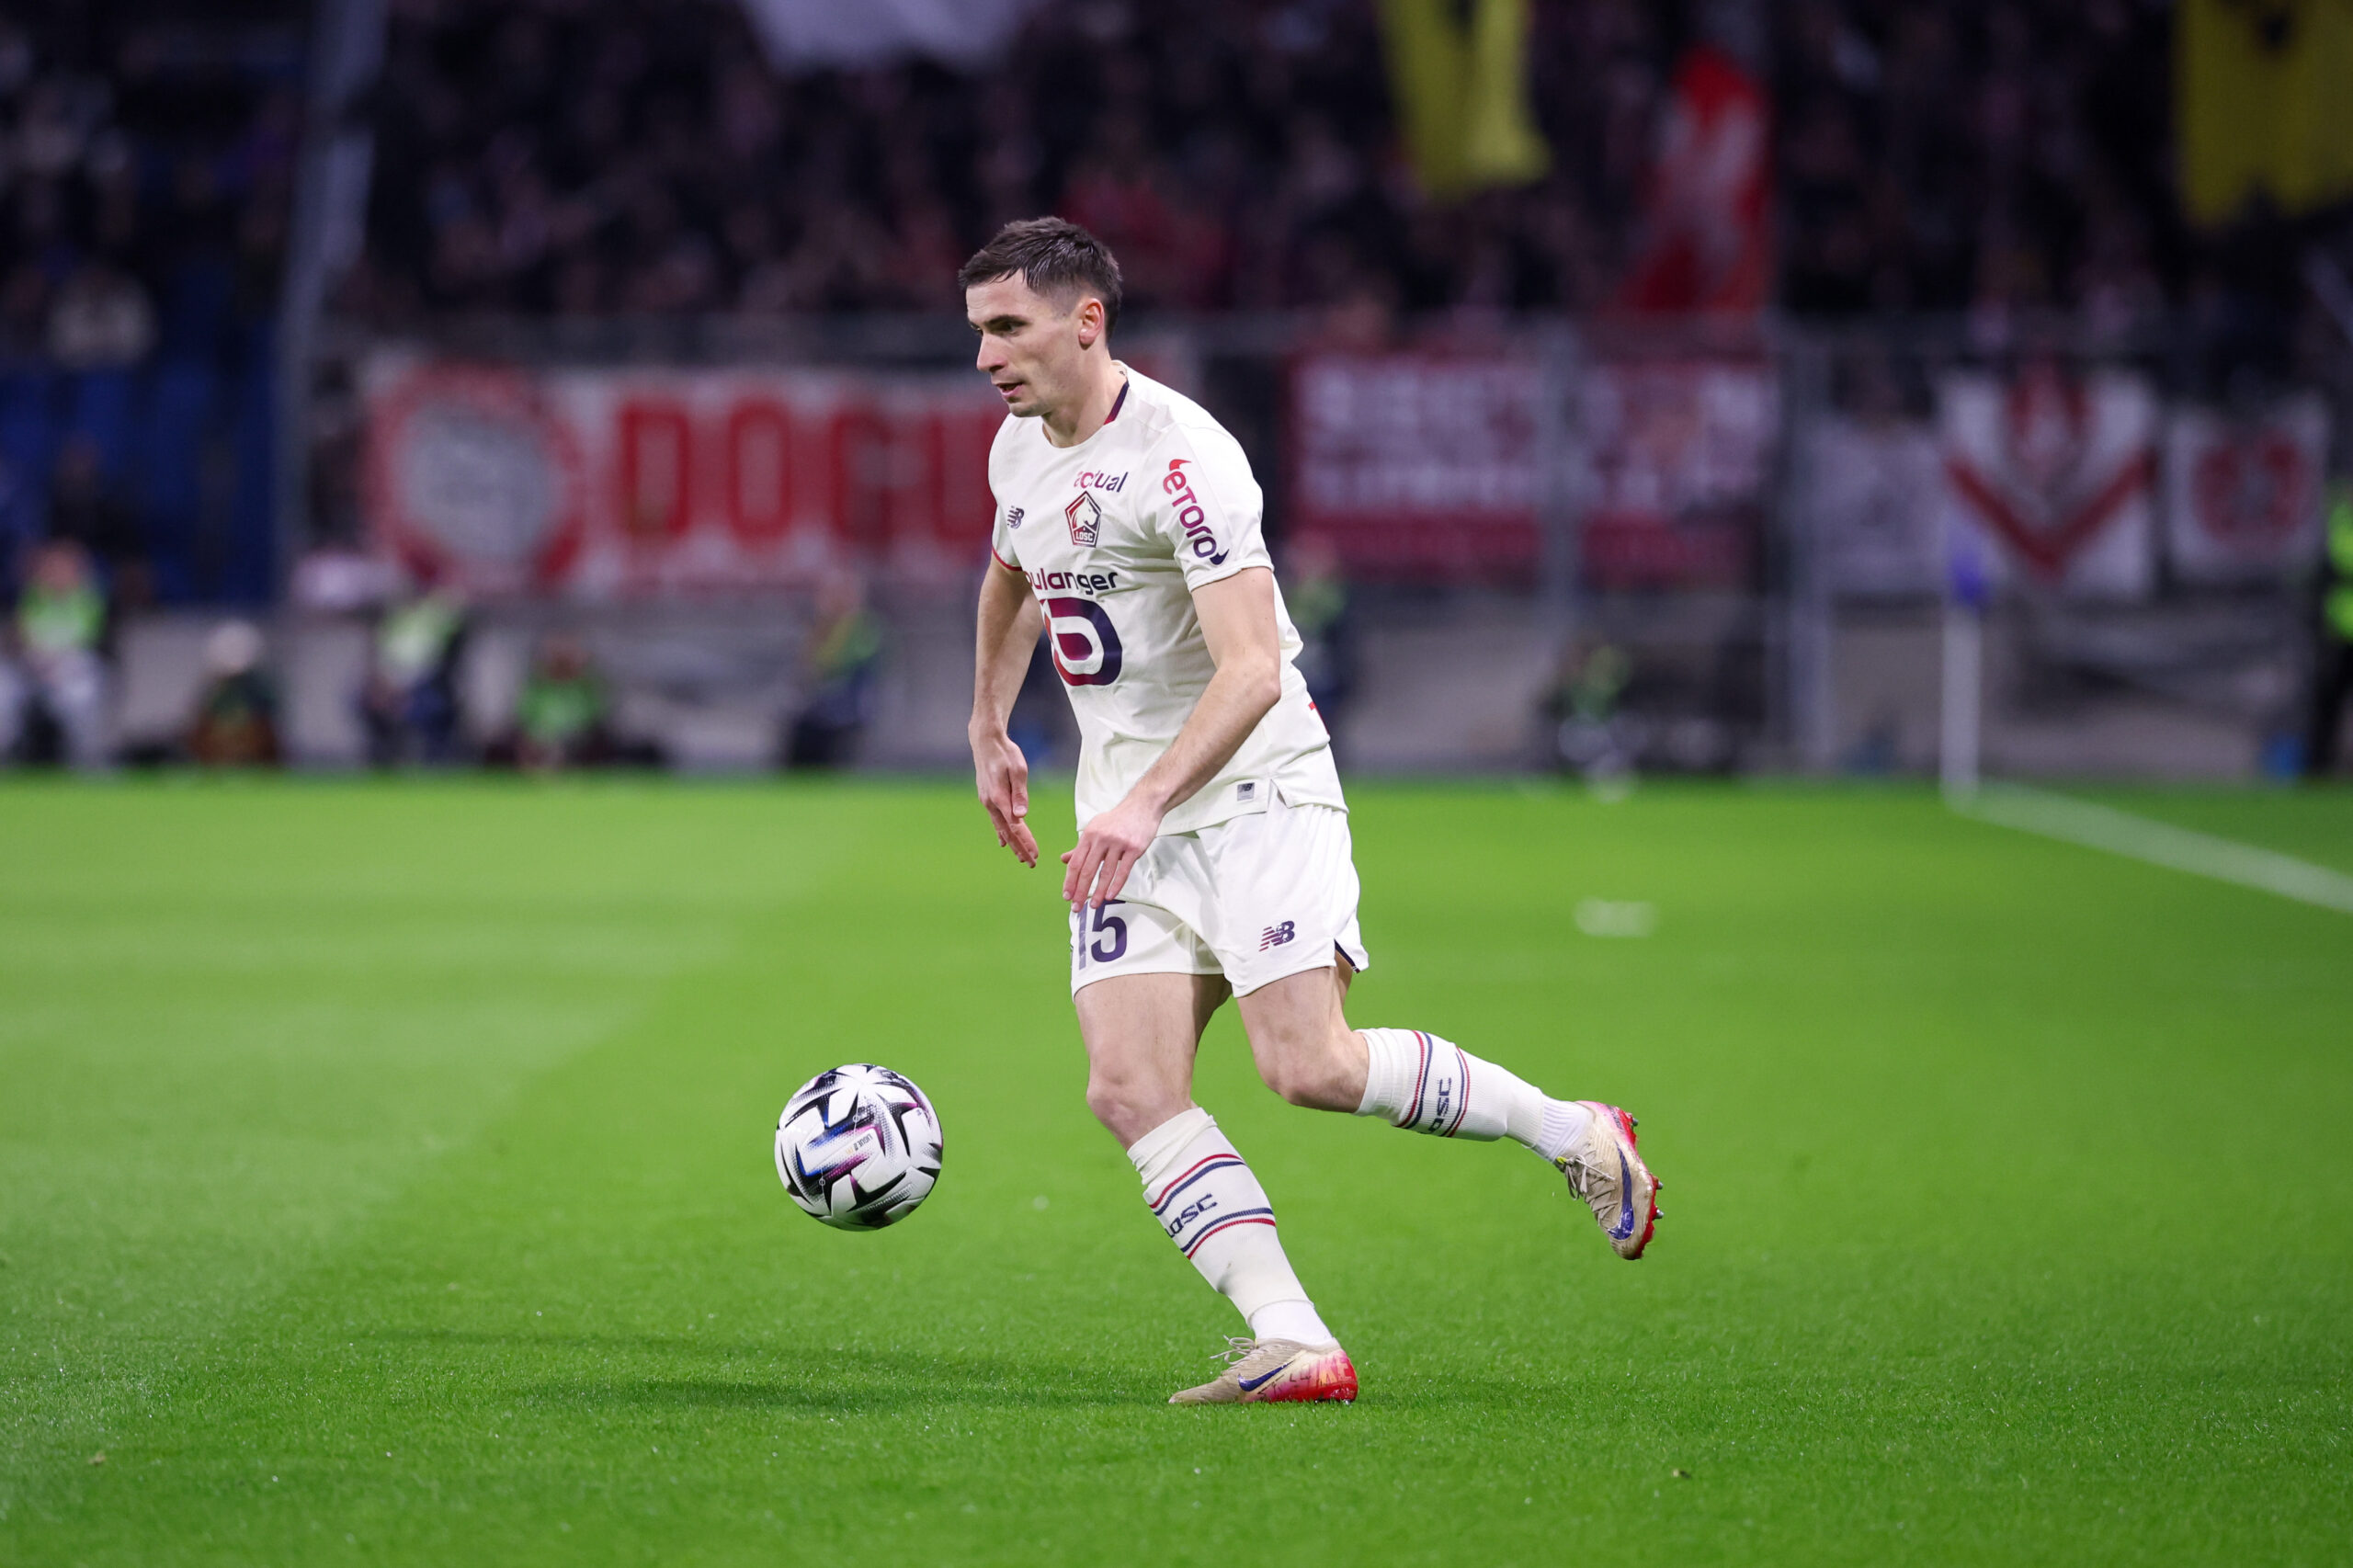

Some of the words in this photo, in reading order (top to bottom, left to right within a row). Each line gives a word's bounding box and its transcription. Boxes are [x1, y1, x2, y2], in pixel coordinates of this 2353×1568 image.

[1075, 530, 1094, 541] LOSC
[1023, 567, 1119, 596] oulanger
[1077, 898, 1128, 971] 15
[1427, 1077, 1452, 1133] OSC
